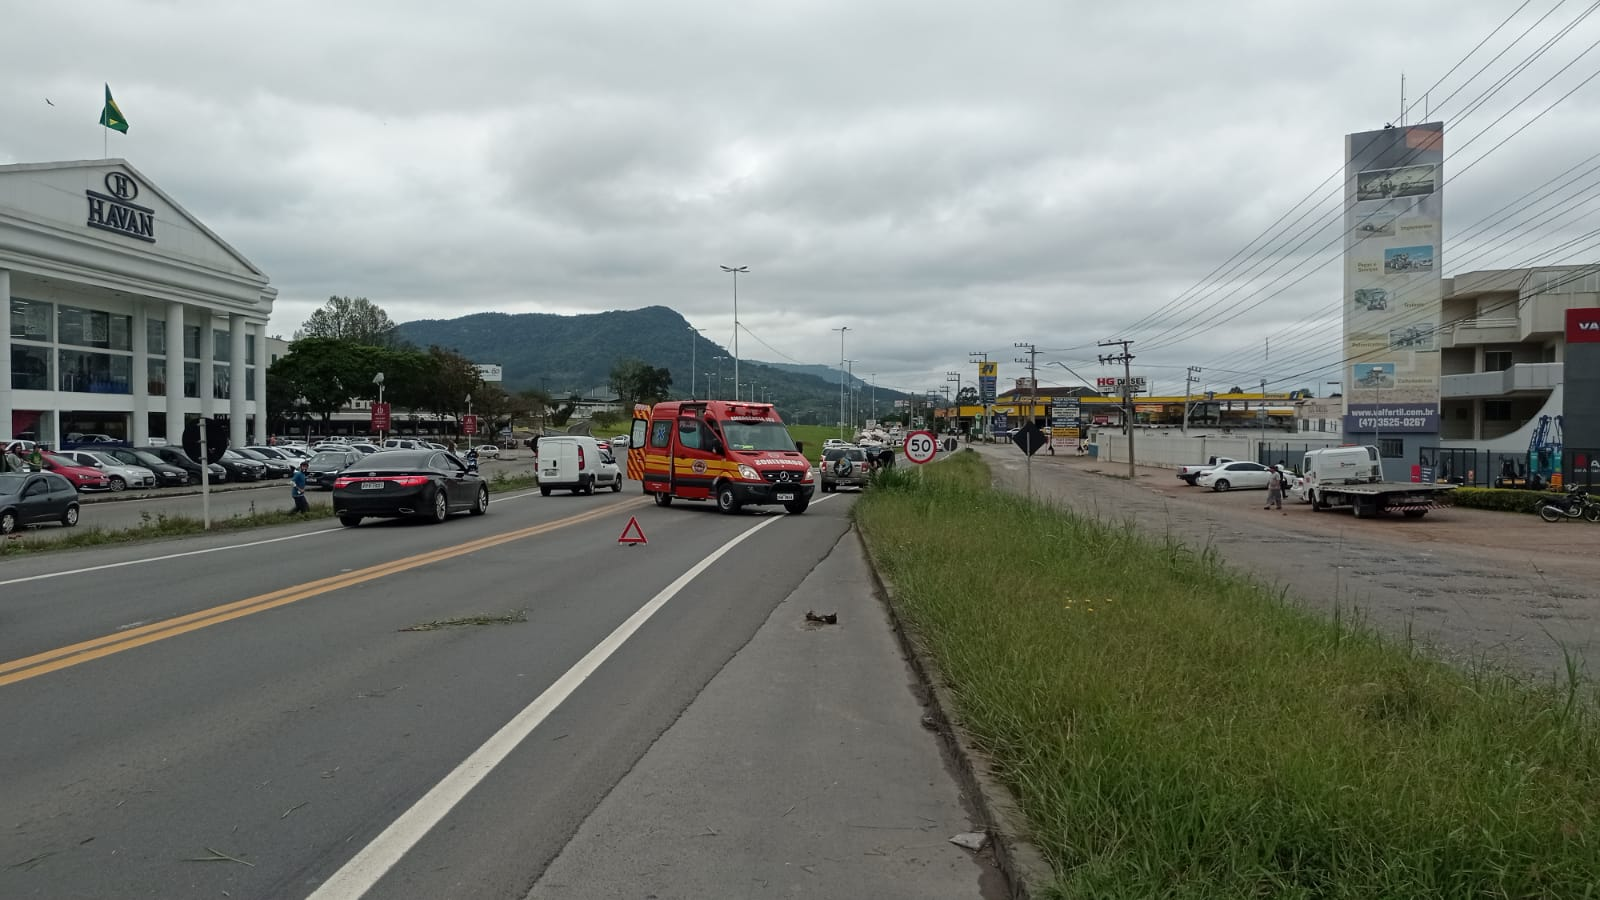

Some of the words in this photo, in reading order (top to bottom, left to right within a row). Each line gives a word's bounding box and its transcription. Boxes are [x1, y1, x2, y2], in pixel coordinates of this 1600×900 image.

[114, 175, 130, 197] H
[88, 196, 154, 237] HAVAN
[1579, 322, 1600, 330] VA
[1097, 378, 1115, 386] HG
[1352, 408, 1434, 417] www.valfertil.com.br
[911, 439, 931, 453] 50
